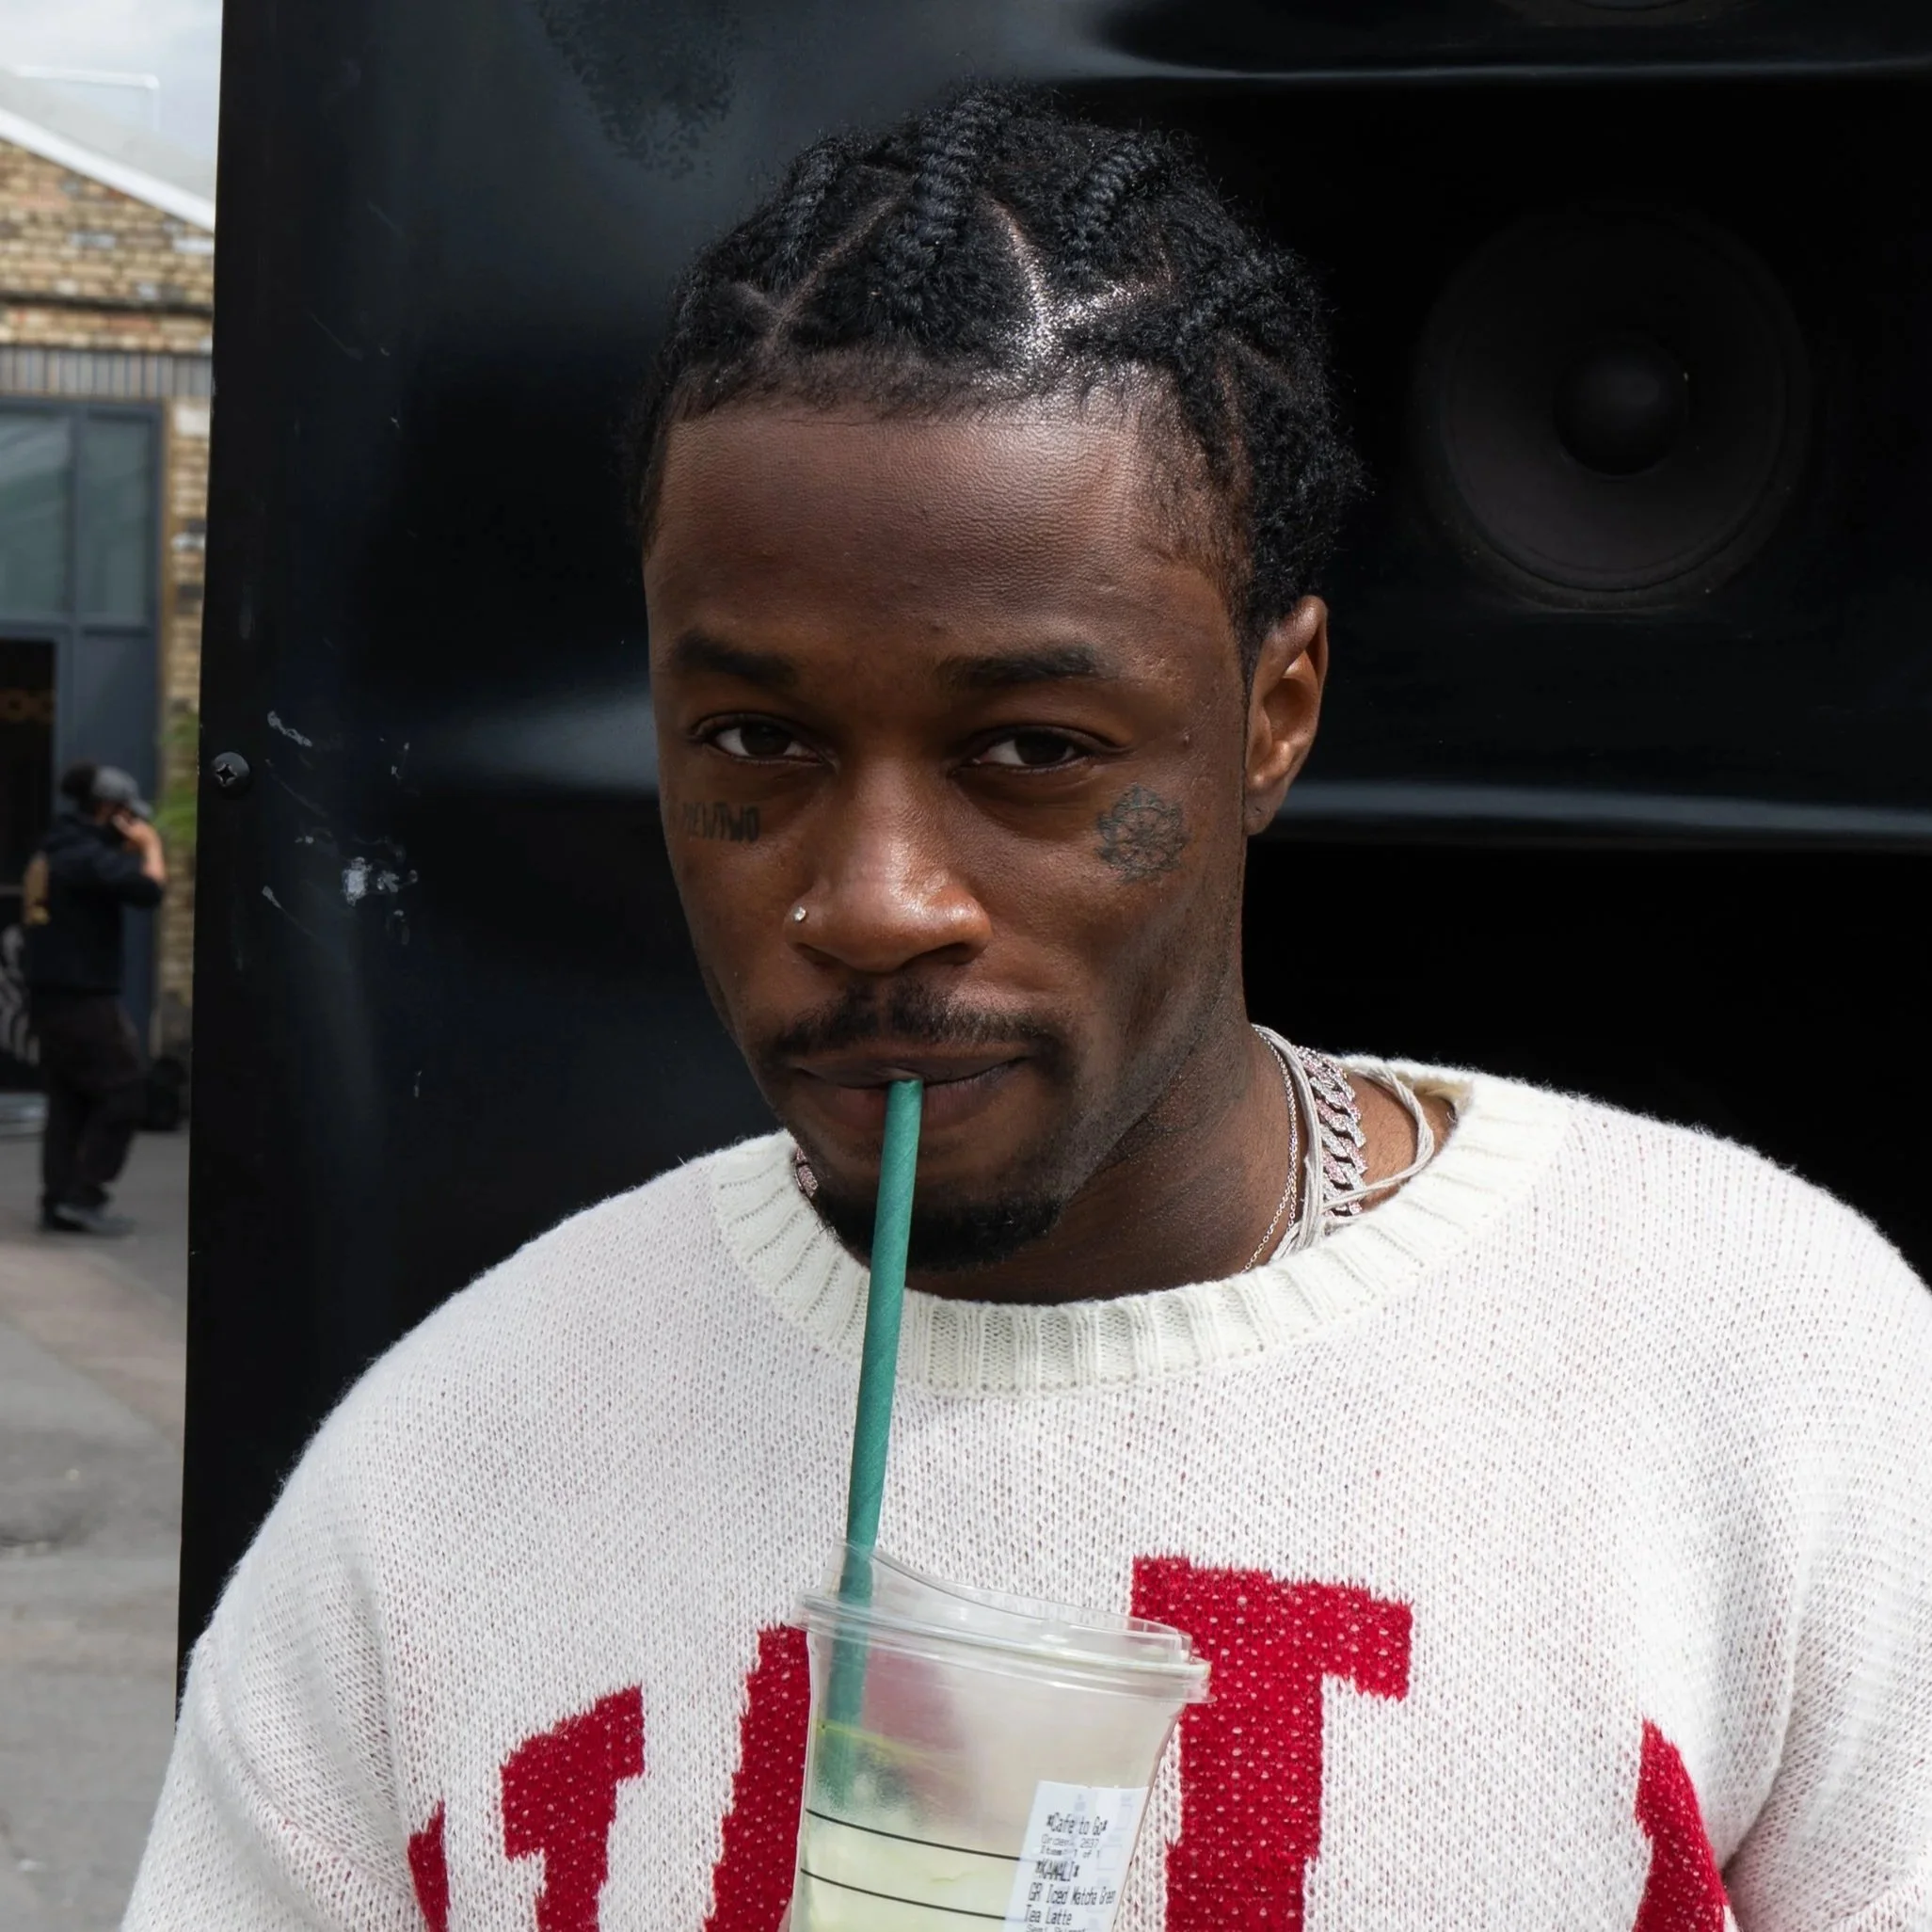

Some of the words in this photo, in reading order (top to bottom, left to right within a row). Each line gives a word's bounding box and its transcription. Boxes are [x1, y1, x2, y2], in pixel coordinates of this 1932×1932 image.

[1078, 1816, 1091, 1835] to
[1082, 1850, 1093, 1860] of
[1046, 1884, 1071, 1905] Iced
[1070, 1886, 1098, 1906] Matcha
[1024, 1904, 1042, 1923] Tea
[1046, 1907, 1073, 1925] Latte
